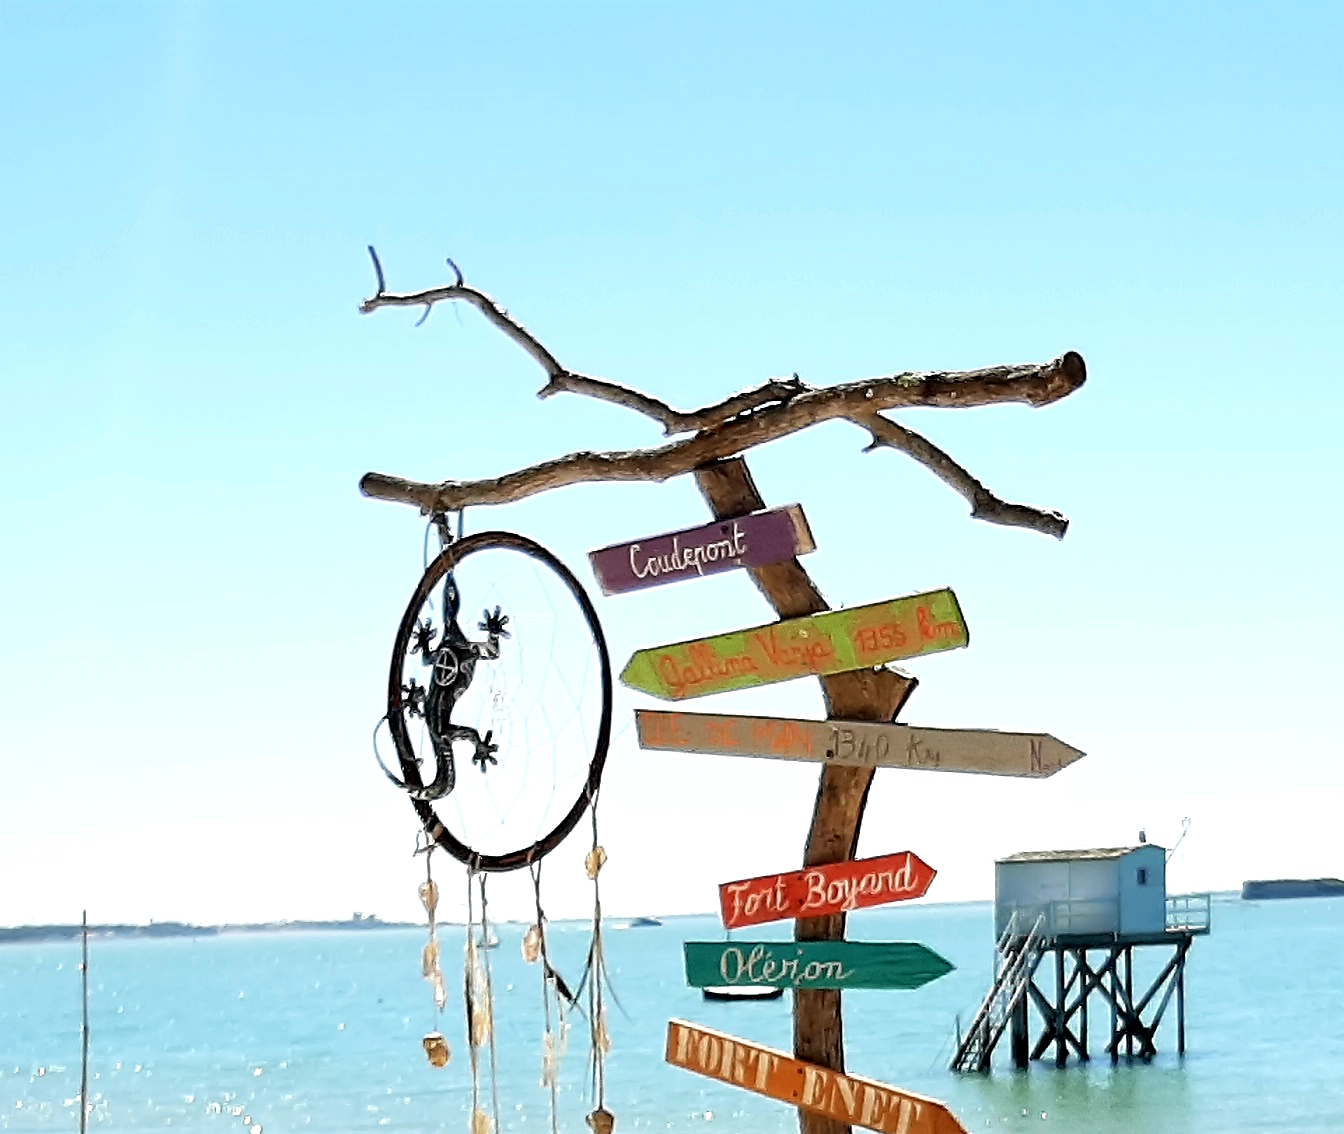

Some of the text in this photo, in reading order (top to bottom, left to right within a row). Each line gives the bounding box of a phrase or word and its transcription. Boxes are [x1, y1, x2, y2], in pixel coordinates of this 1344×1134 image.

[629, 522, 748, 578] Coudepont
[727, 852, 919, 926] Fort Boyard
[674, 1026, 778, 1092] FORT
